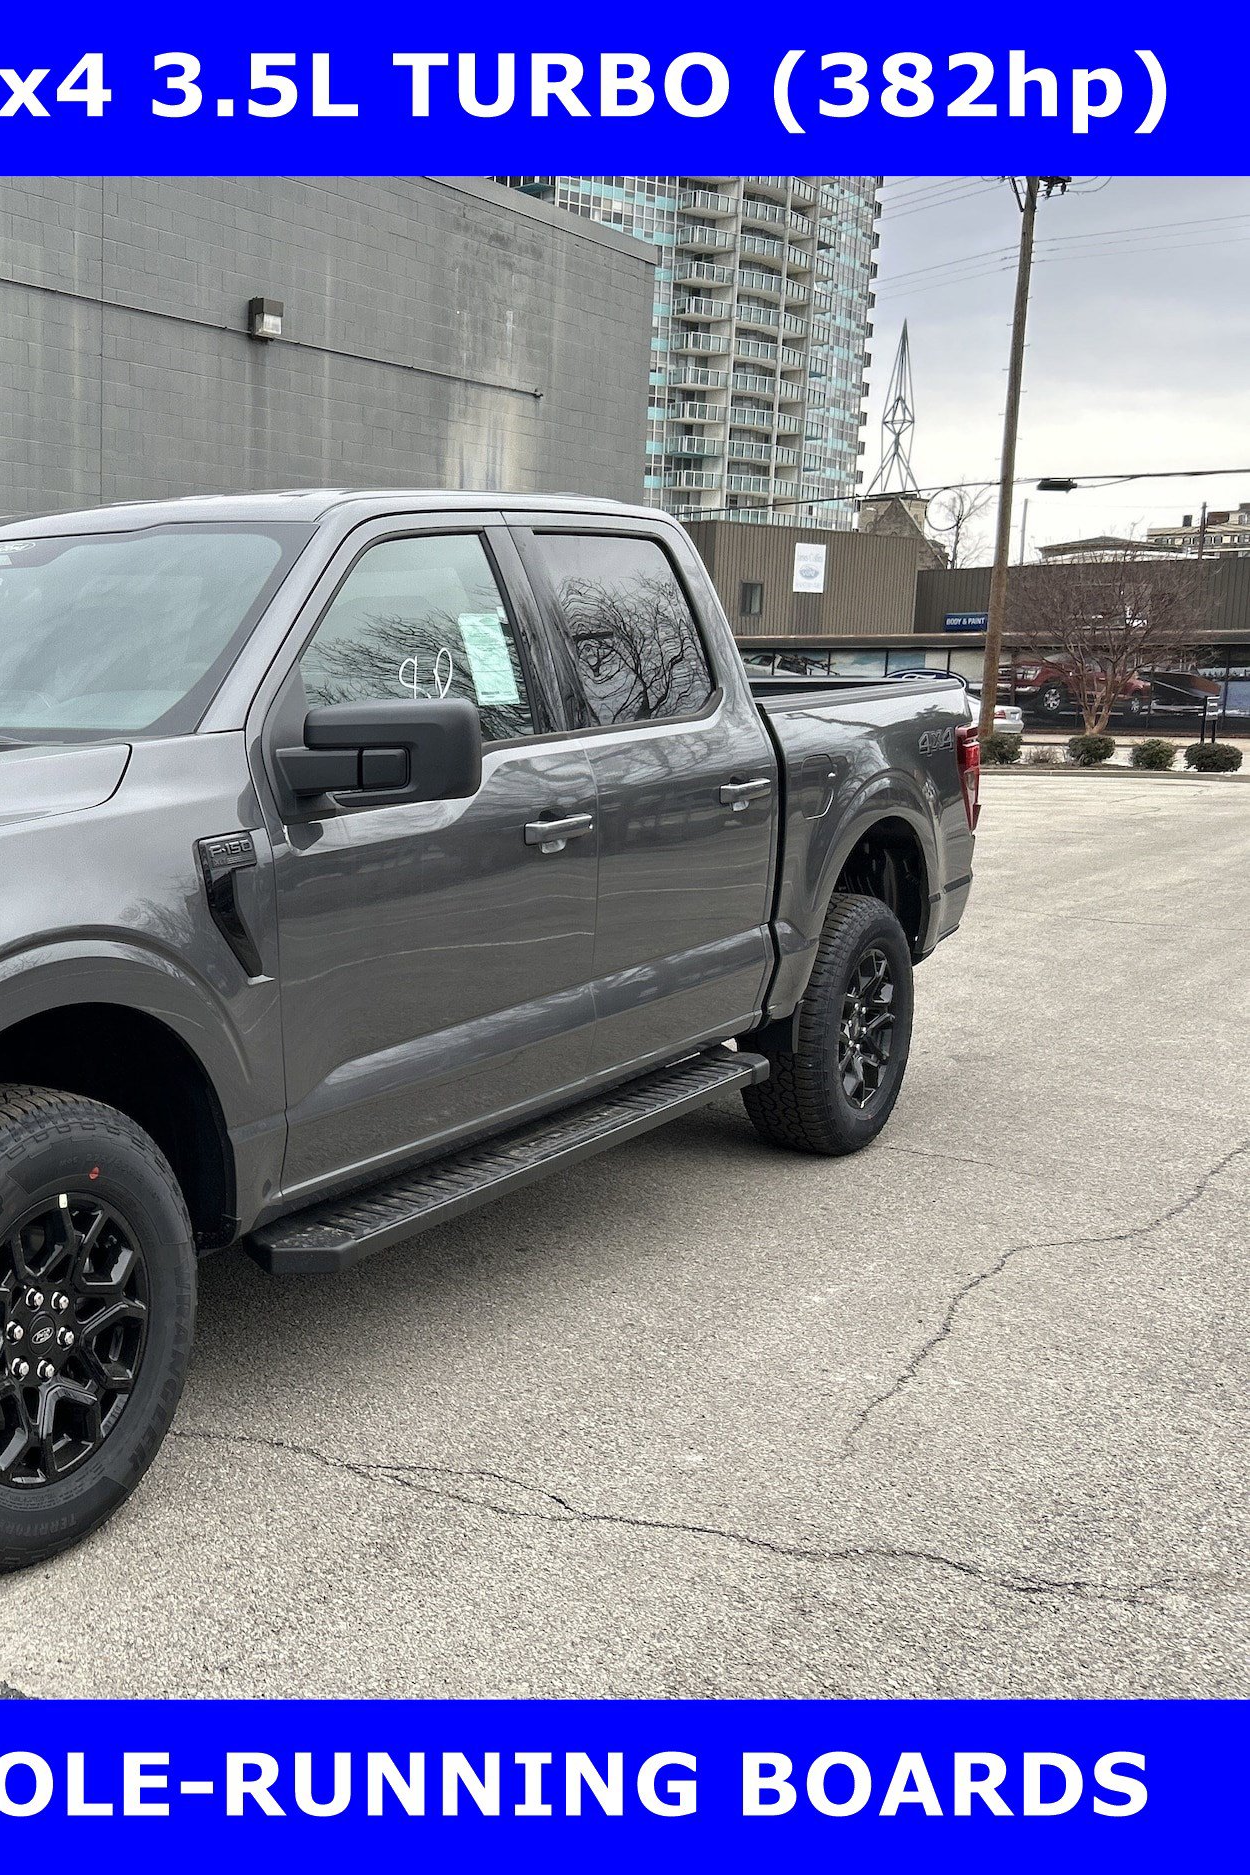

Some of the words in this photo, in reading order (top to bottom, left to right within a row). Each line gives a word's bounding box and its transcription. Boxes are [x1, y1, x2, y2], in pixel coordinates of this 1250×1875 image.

[945, 617, 961, 626] BODY
[968, 616, 986, 625] PAINT
[208, 839, 253, 857] F-150
